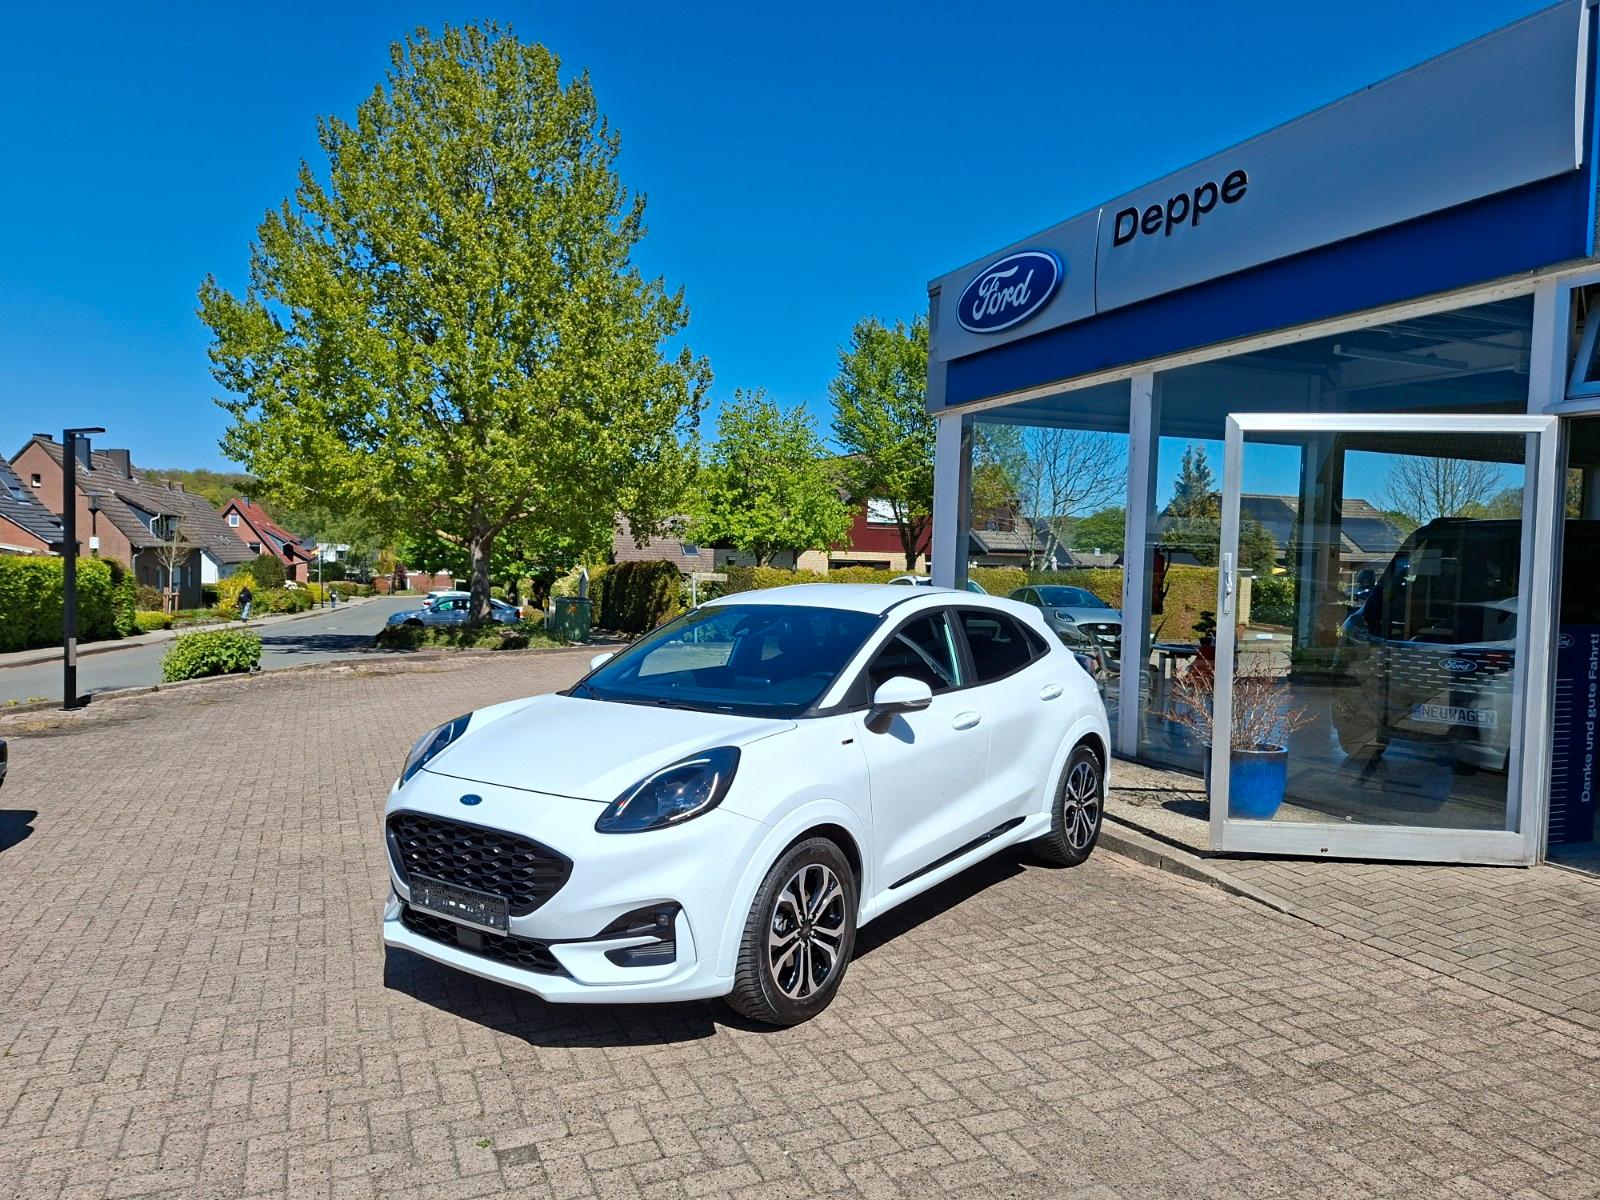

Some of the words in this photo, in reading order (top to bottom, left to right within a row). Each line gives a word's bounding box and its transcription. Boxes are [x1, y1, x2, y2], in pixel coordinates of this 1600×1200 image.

[1113, 169, 1248, 247] Deppe
[972, 265, 1034, 321] Ford
[1444, 660, 1470, 670] Ford
[1588, 633, 1600, 680] Fahrt!
[1423, 705, 1495, 724] NEUWAGEN
[1587, 683, 1597, 718] gute
[1585, 721, 1595, 750] und
[1581, 753, 1592, 802] Danke
